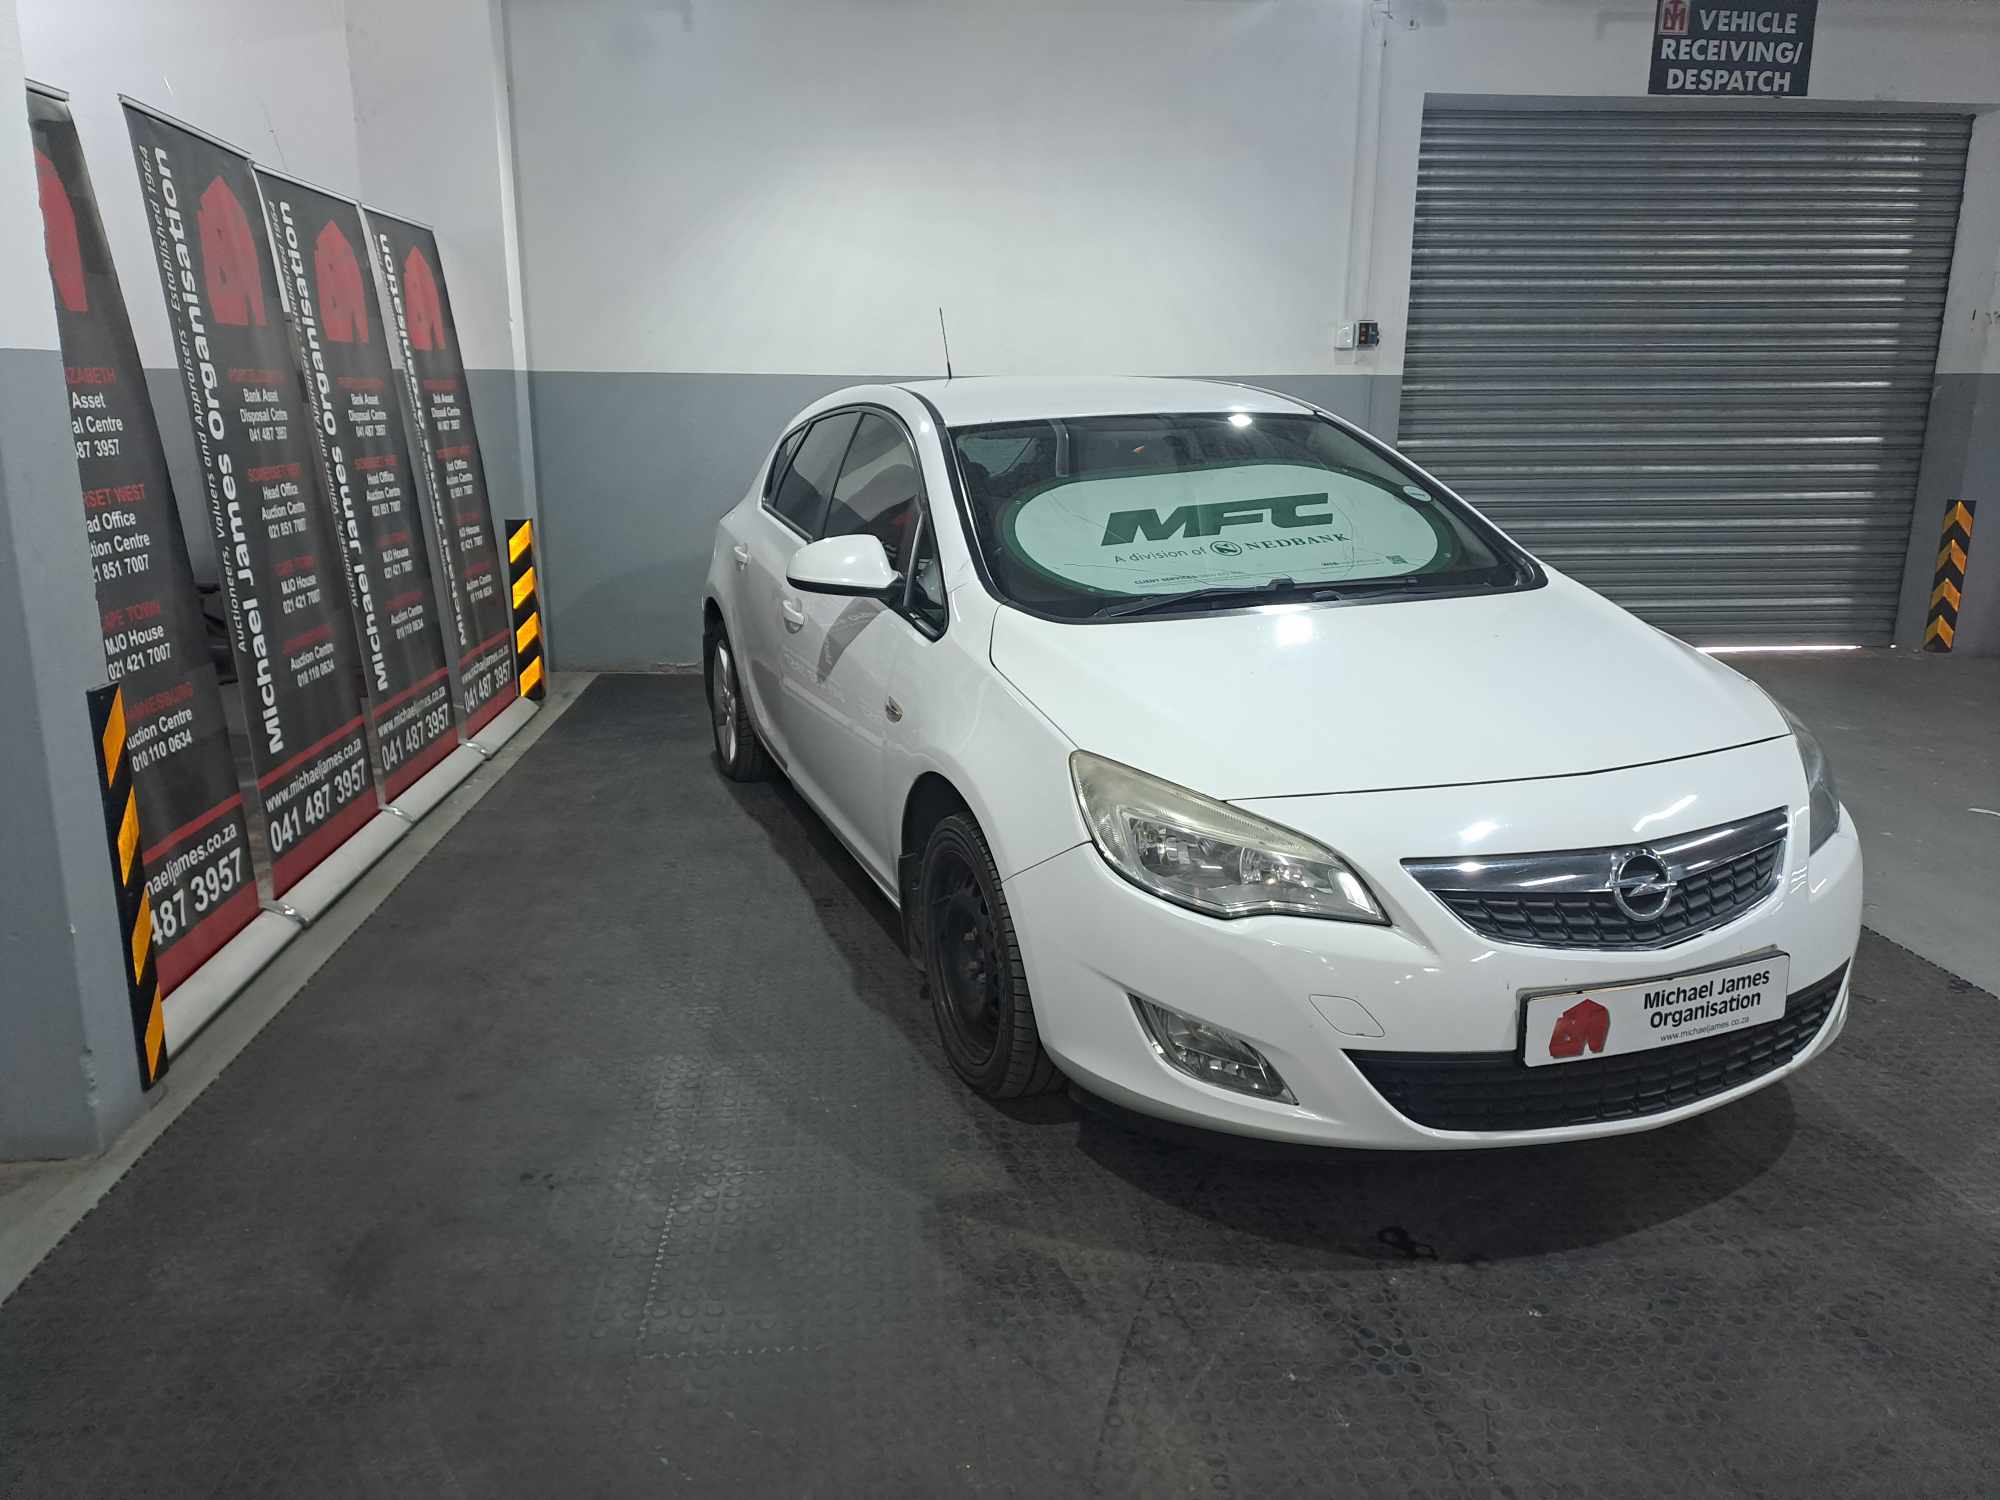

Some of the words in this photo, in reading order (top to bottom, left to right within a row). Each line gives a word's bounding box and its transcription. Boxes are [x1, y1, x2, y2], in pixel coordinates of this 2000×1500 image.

[1700, 9, 1798, 34] VEHICLE
[1660, 38, 1804, 64] RECEIVING/
[1666, 68, 1792, 93] DESPATCH
[139, 145, 156, 194] 1964
[150, 199, 180, 312] Established
[155, 147, 224, 440] Organisation
[280, 201, 337, 436] Organisation
[178, 329, 204, 428] Appraisers
[242, 387, 262, 403] Bank
[72, 391, 106, 409] Asset
[239, 408, 271, 425] Disposal
[86, 415, 123, 432] Centre
[248, 428, 262, 442] 041
[76, 440, 90, 458] 87
[94, 438, 120, 457] 3957
[198, 431, 212, 468] and
[102, 510, 137, 530] Office
[207, 473, 226, 538] Valuers
[218, 453, 254, 586] James
[261, 504, 287, 521] Auction
[331, 446, 362, 555] James
[1101, 492, 1333, 546] MFC
[114, 532, 150, 552] Centre
[268, 524, 280, 539] 021
[1114, 553, 1126, 564] A
[1129, 548, 1189, 564] division
[1191, 546, 1208, 558] of
[1243, 533, 1351, 551] NEDBANK
[102, 560, 122, 580] 851
[124, 553, 150, 574] 7007
[221, 546, 247, 653] Auctioneers,
[105, 633, 127, 656] MJO
[128, 625, 165, 647] House
[353, 564, 389, 691] Michael
[108, 659, 126, 681] 021
[126, 651, 145, 673] 421
[147, 642, 172, 666] 7007
[243, 598, 284, 754] Michael
[464, 683, 479, 713] 041
[478, 673, 492, 701] 487
[494, 660, 510, 688] 3957
[127, 722, 157, 751] uction
[159, 708, 193, 733] Centre
[382, 735, 403, 771] 041
[405, 721, 424, 752] 487
[426, 703, 448, 738] 3957
[132, 751, 149, 772] 010
[149, 740, 167, 763] 110
[168, 728, 193, 753] 0634
[265, 738, 362, 813] www.michaeljames.co.za
[270, 806, 301, 853] 041
[304, 783, 331, 825] 487
[334, 758, 365, 804] 3957
[190, 846, 241, 912] 3957
[1643, 980, 1715, 1010] Michael
[1718, 969, 1770, 996] James
[1650, 991, 1761, 1028] Organisation
[1660, 1016, 1750, 1041] www.michaeljames.co.za
